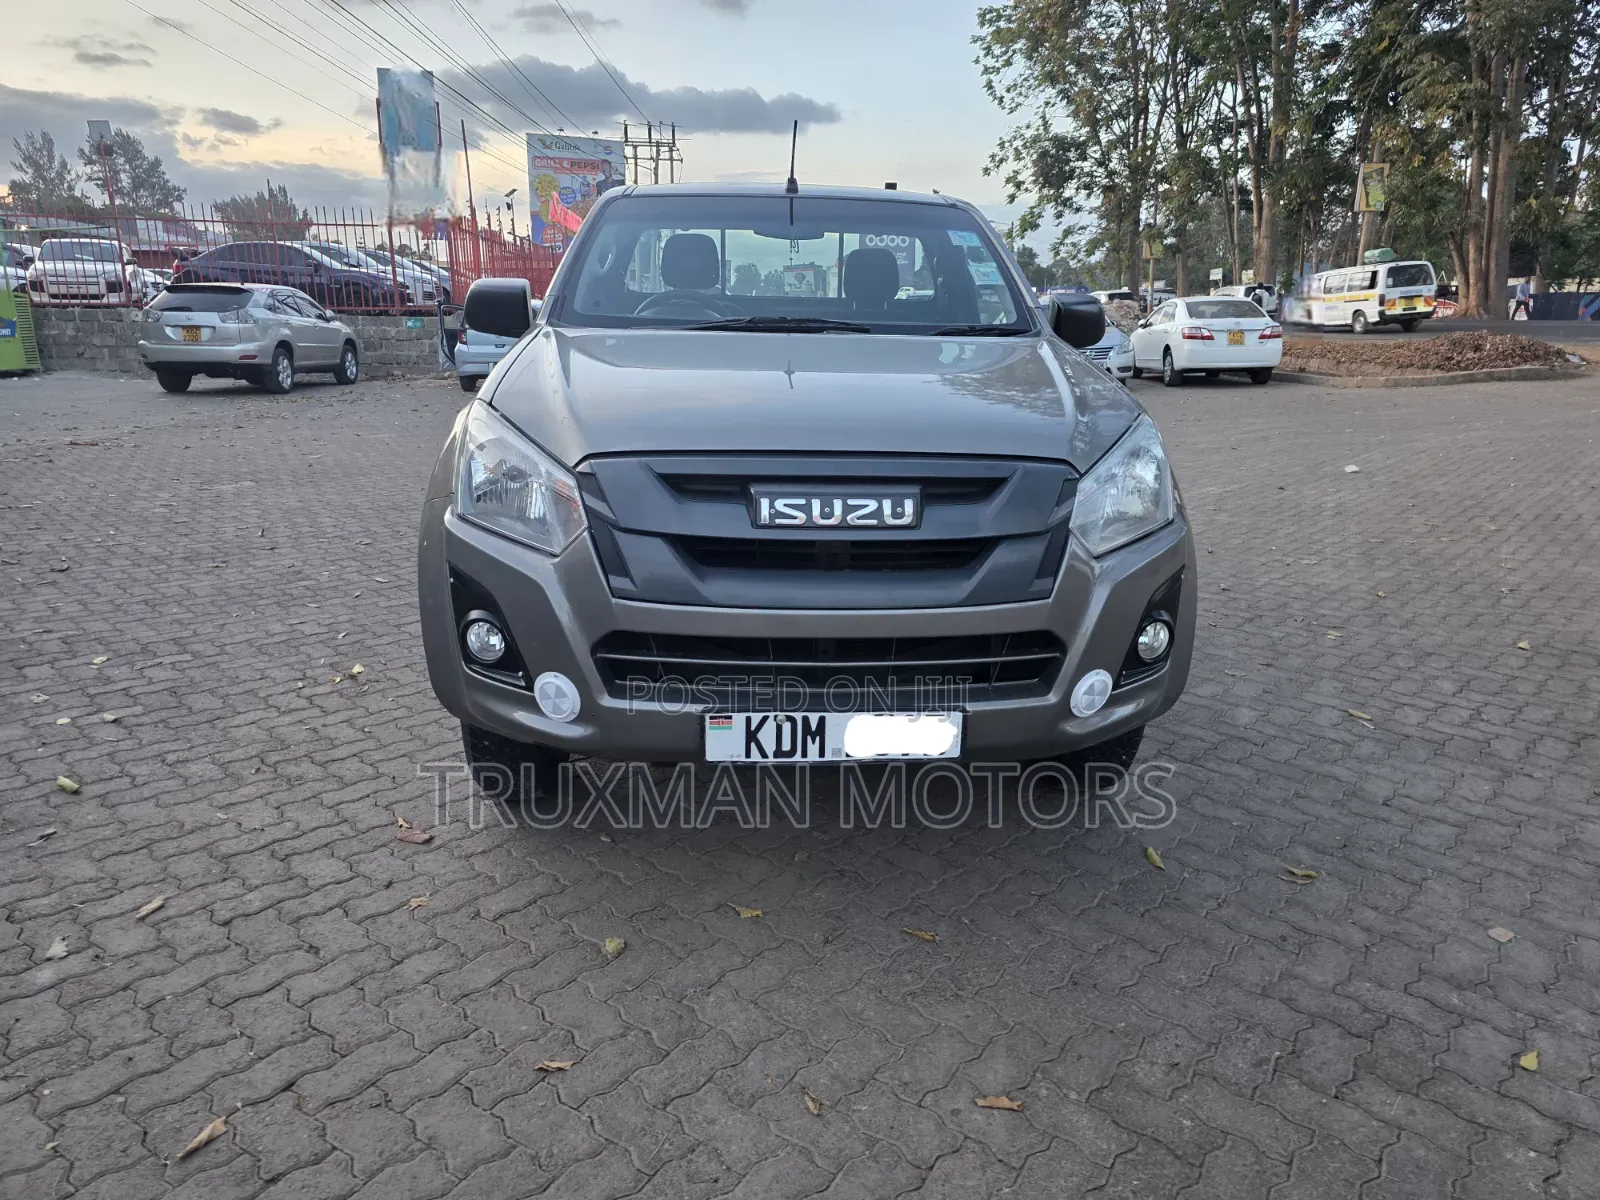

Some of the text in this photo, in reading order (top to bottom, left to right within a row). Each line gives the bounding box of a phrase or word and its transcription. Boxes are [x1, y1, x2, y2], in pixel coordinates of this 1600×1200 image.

[535, 158, 600, 170] GRILL & PEPSI
[760, 497, 914, 525] ISUZU
[745, 714, 826, 759] KDM
